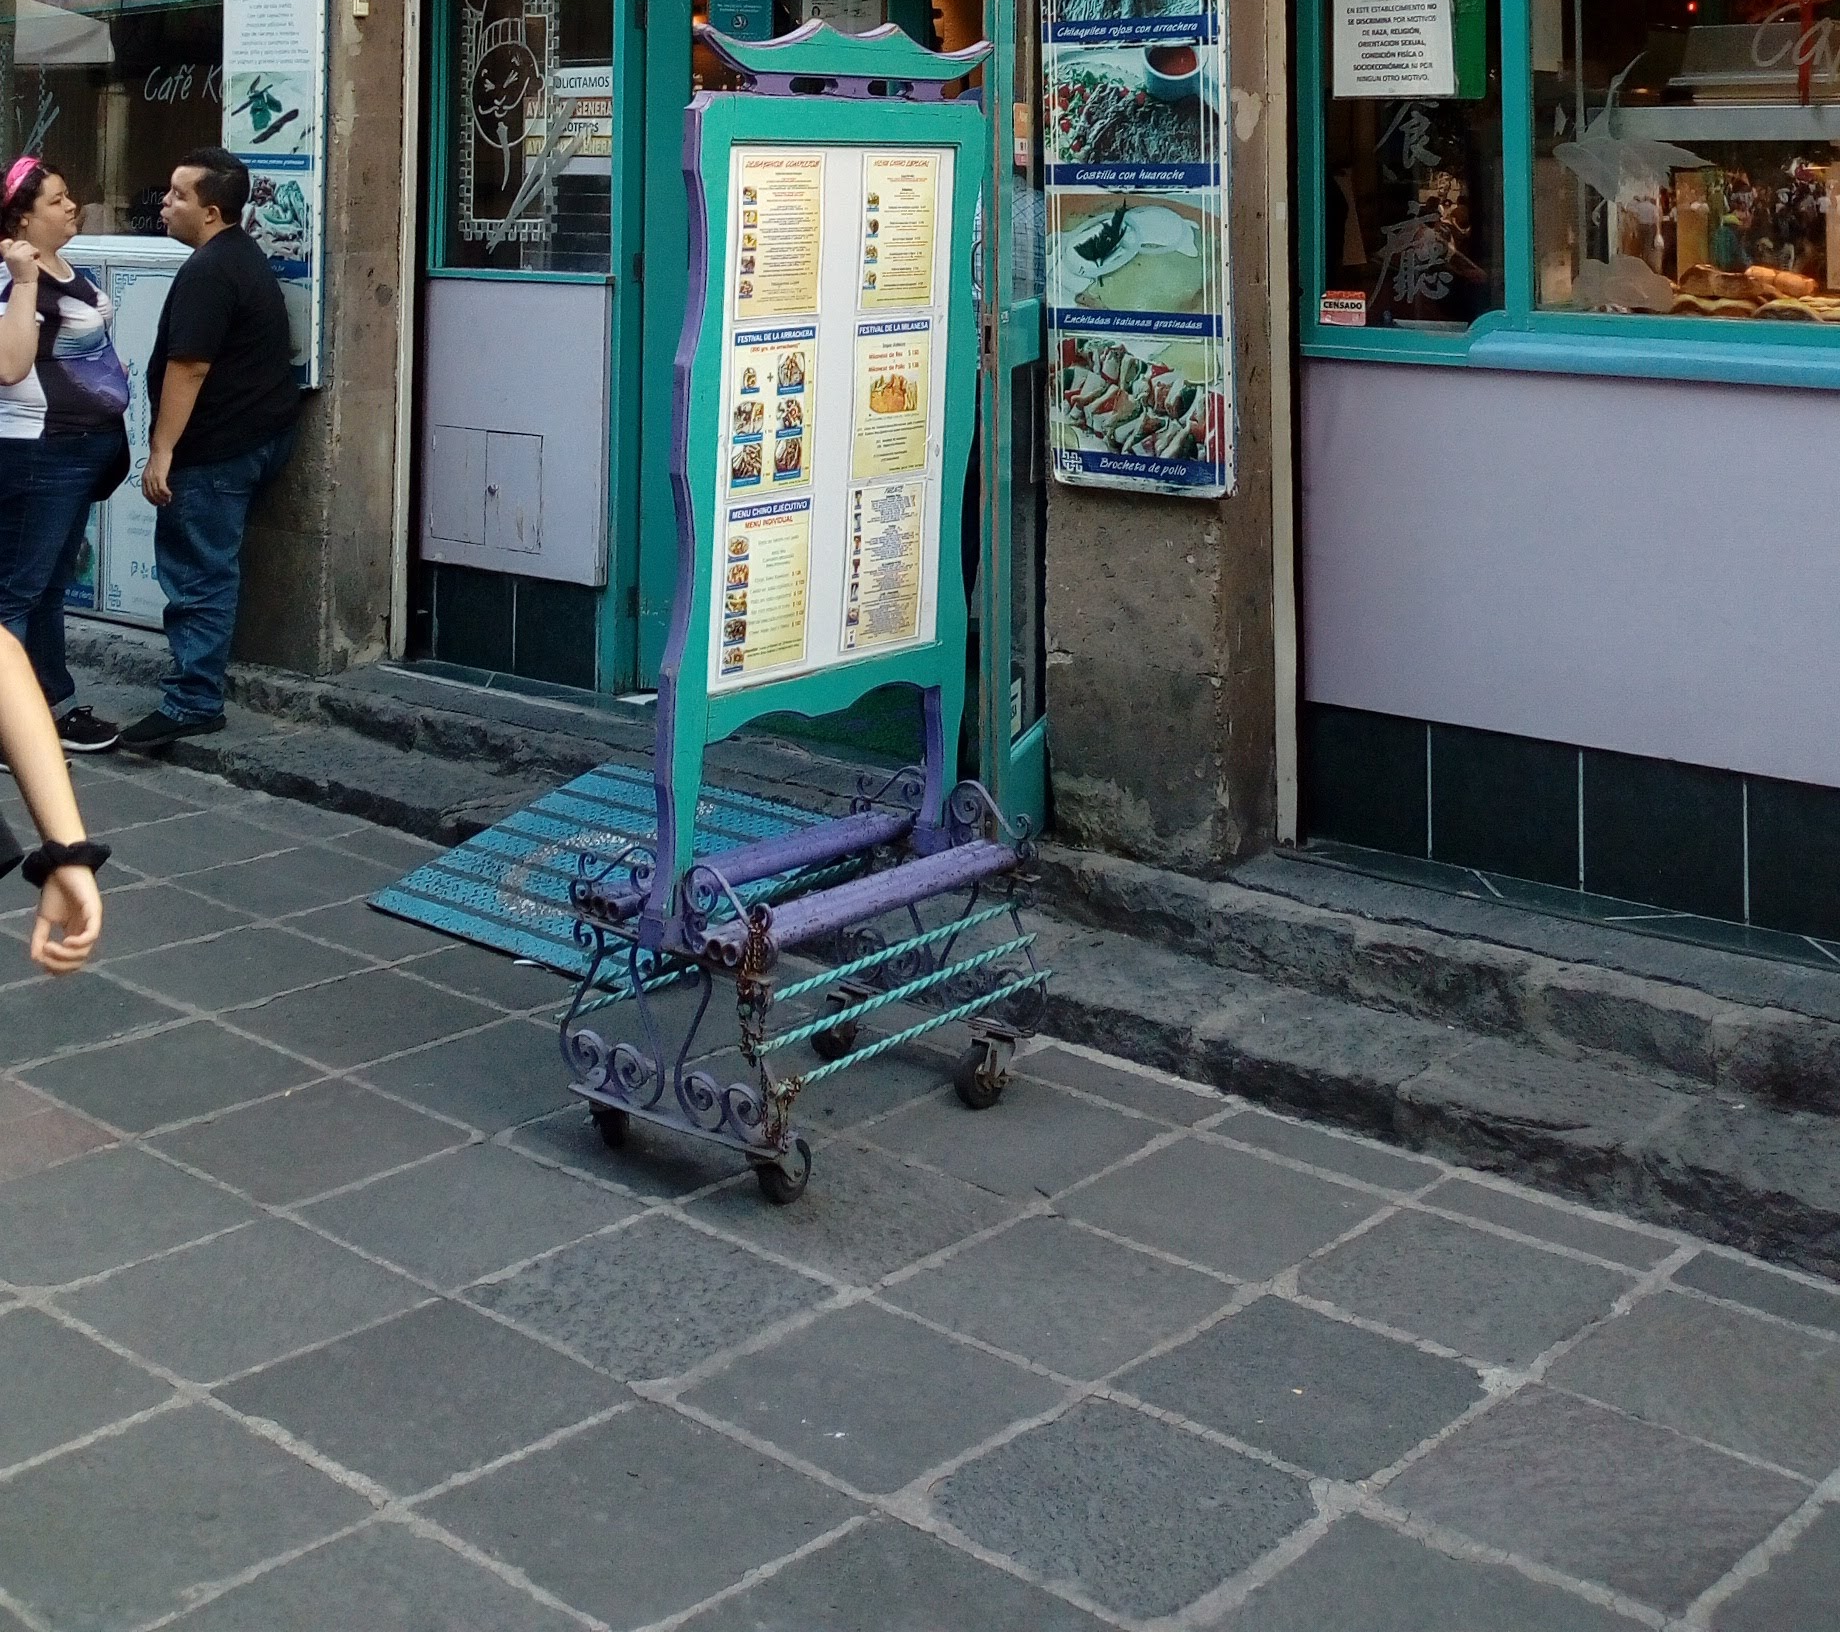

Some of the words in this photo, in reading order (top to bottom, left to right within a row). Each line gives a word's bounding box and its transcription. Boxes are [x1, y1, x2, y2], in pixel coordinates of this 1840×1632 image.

[1346, 6, 1355, 14] EN
[1356, 5, 1370, 14] ESTE
[1371, 3, 1426, 13] ESTABLECIMIENTO
[1355, 17, 1392, 25] DISCRIMINA
[1406, 14, 1437, 23] MOTIVOS
[1057, 26, 1107, 39] Chilaquiles
[1108, 24, 1133, 37] rojos
[1134, 24, 1152, 34] con
[1152, 21, 1198, 32] arrachera
[1371, 28, 1389, 36] RAZA,
[1361, 50, 1396, 59] CONDICIÓN
[1417, 50, 1424, 58] O
[1353, 62, 1410, 71] SOCIOECONÓMICA
[143, 63, 196, 105] Café
[553, 75, 610, 89] OLICITAMOS
[1075, 169, 1116, 181] Costilla
[1118, 170, 1135, 180] con
[1138, 169, 1185, 181] huarache
[131, 215, 152, 229] con
[1323, 301, 1363, 310] CENSADO
[859, 325, 884, 335] FESTIVAL
[884, 323, 893, 332] DE
[893, 323, 901, 331] LA
[900, 321, 929, 331] MILANESA
[1063, 313, 1110, 326] Enchiladas
[1153, 318, 1203, 330] gratinadas
[737, 333, 763, 344] FESTIVAL
[763, 332, 772, 342] DE
[772, 331, 780, 341] LA
[780, 329, 814, 340] ARRACHERA
[1099, 457, 1146, 471] Brocheta
[1148, 461, 1160, 473] de
[1161, 462, 1187, 476] pollo
[732, 508, 752, 520] MENU
[752, 505, 772, 517] CHINO
[773, 500, 808, 513] EJECUTIVO
[744, 519, 762, 529] MENU
[762, 515, 794, 526] INDIVIDUAL
